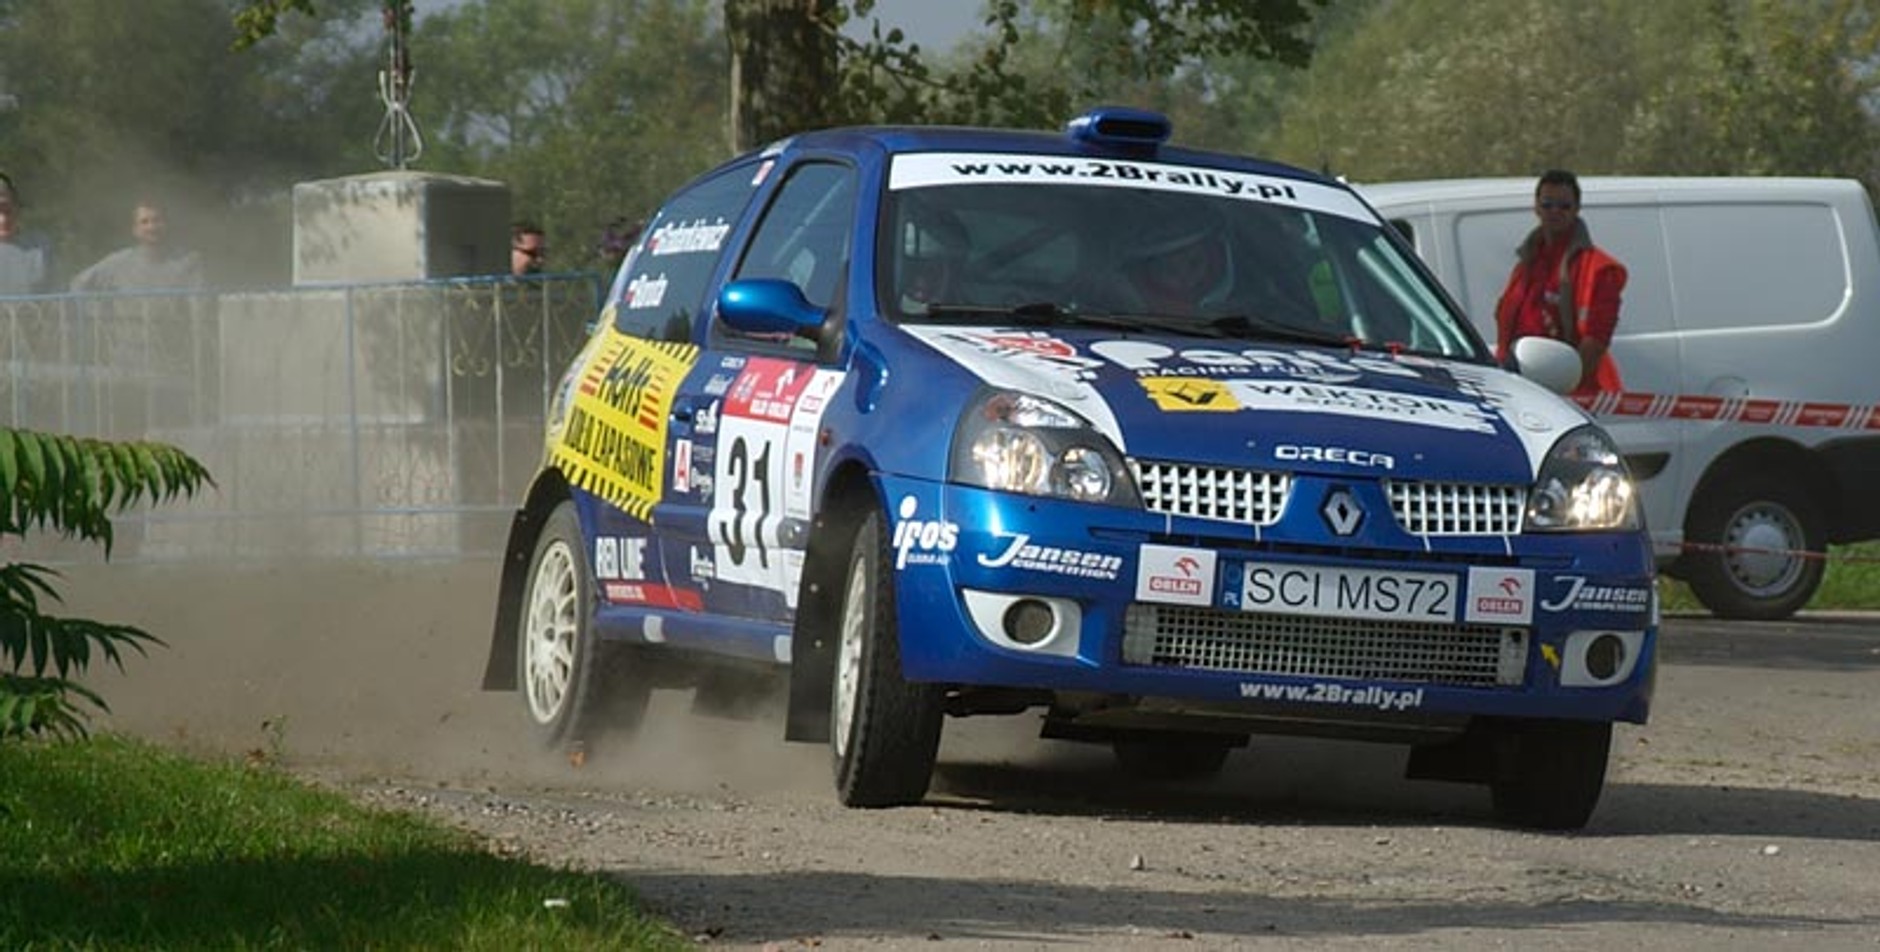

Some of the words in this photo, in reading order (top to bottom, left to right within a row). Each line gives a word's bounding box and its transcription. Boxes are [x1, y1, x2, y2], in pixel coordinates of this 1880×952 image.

[952, 161, 1298, 200] www.2Brally.pl
[1138, 364, 1248, 378] RACING
[1246, 383, 1456, 414] WEKTOR
[1275, 444, 1394, 469] ORECA
[719, 435, 771, 569] 31
[977, 530, 1122, 570] Jansen
[1151, 579, 1199, 594] ORLEN
[1247, 568, 1320, 608] SCI
[1337, 574, 1450, 615] MS72
[1540, 575, 1648, 612] Jansen
[1478, 598, 1522, 613] ORLEN
[1240, 682, 1424, 710] www.2Brally.pl
